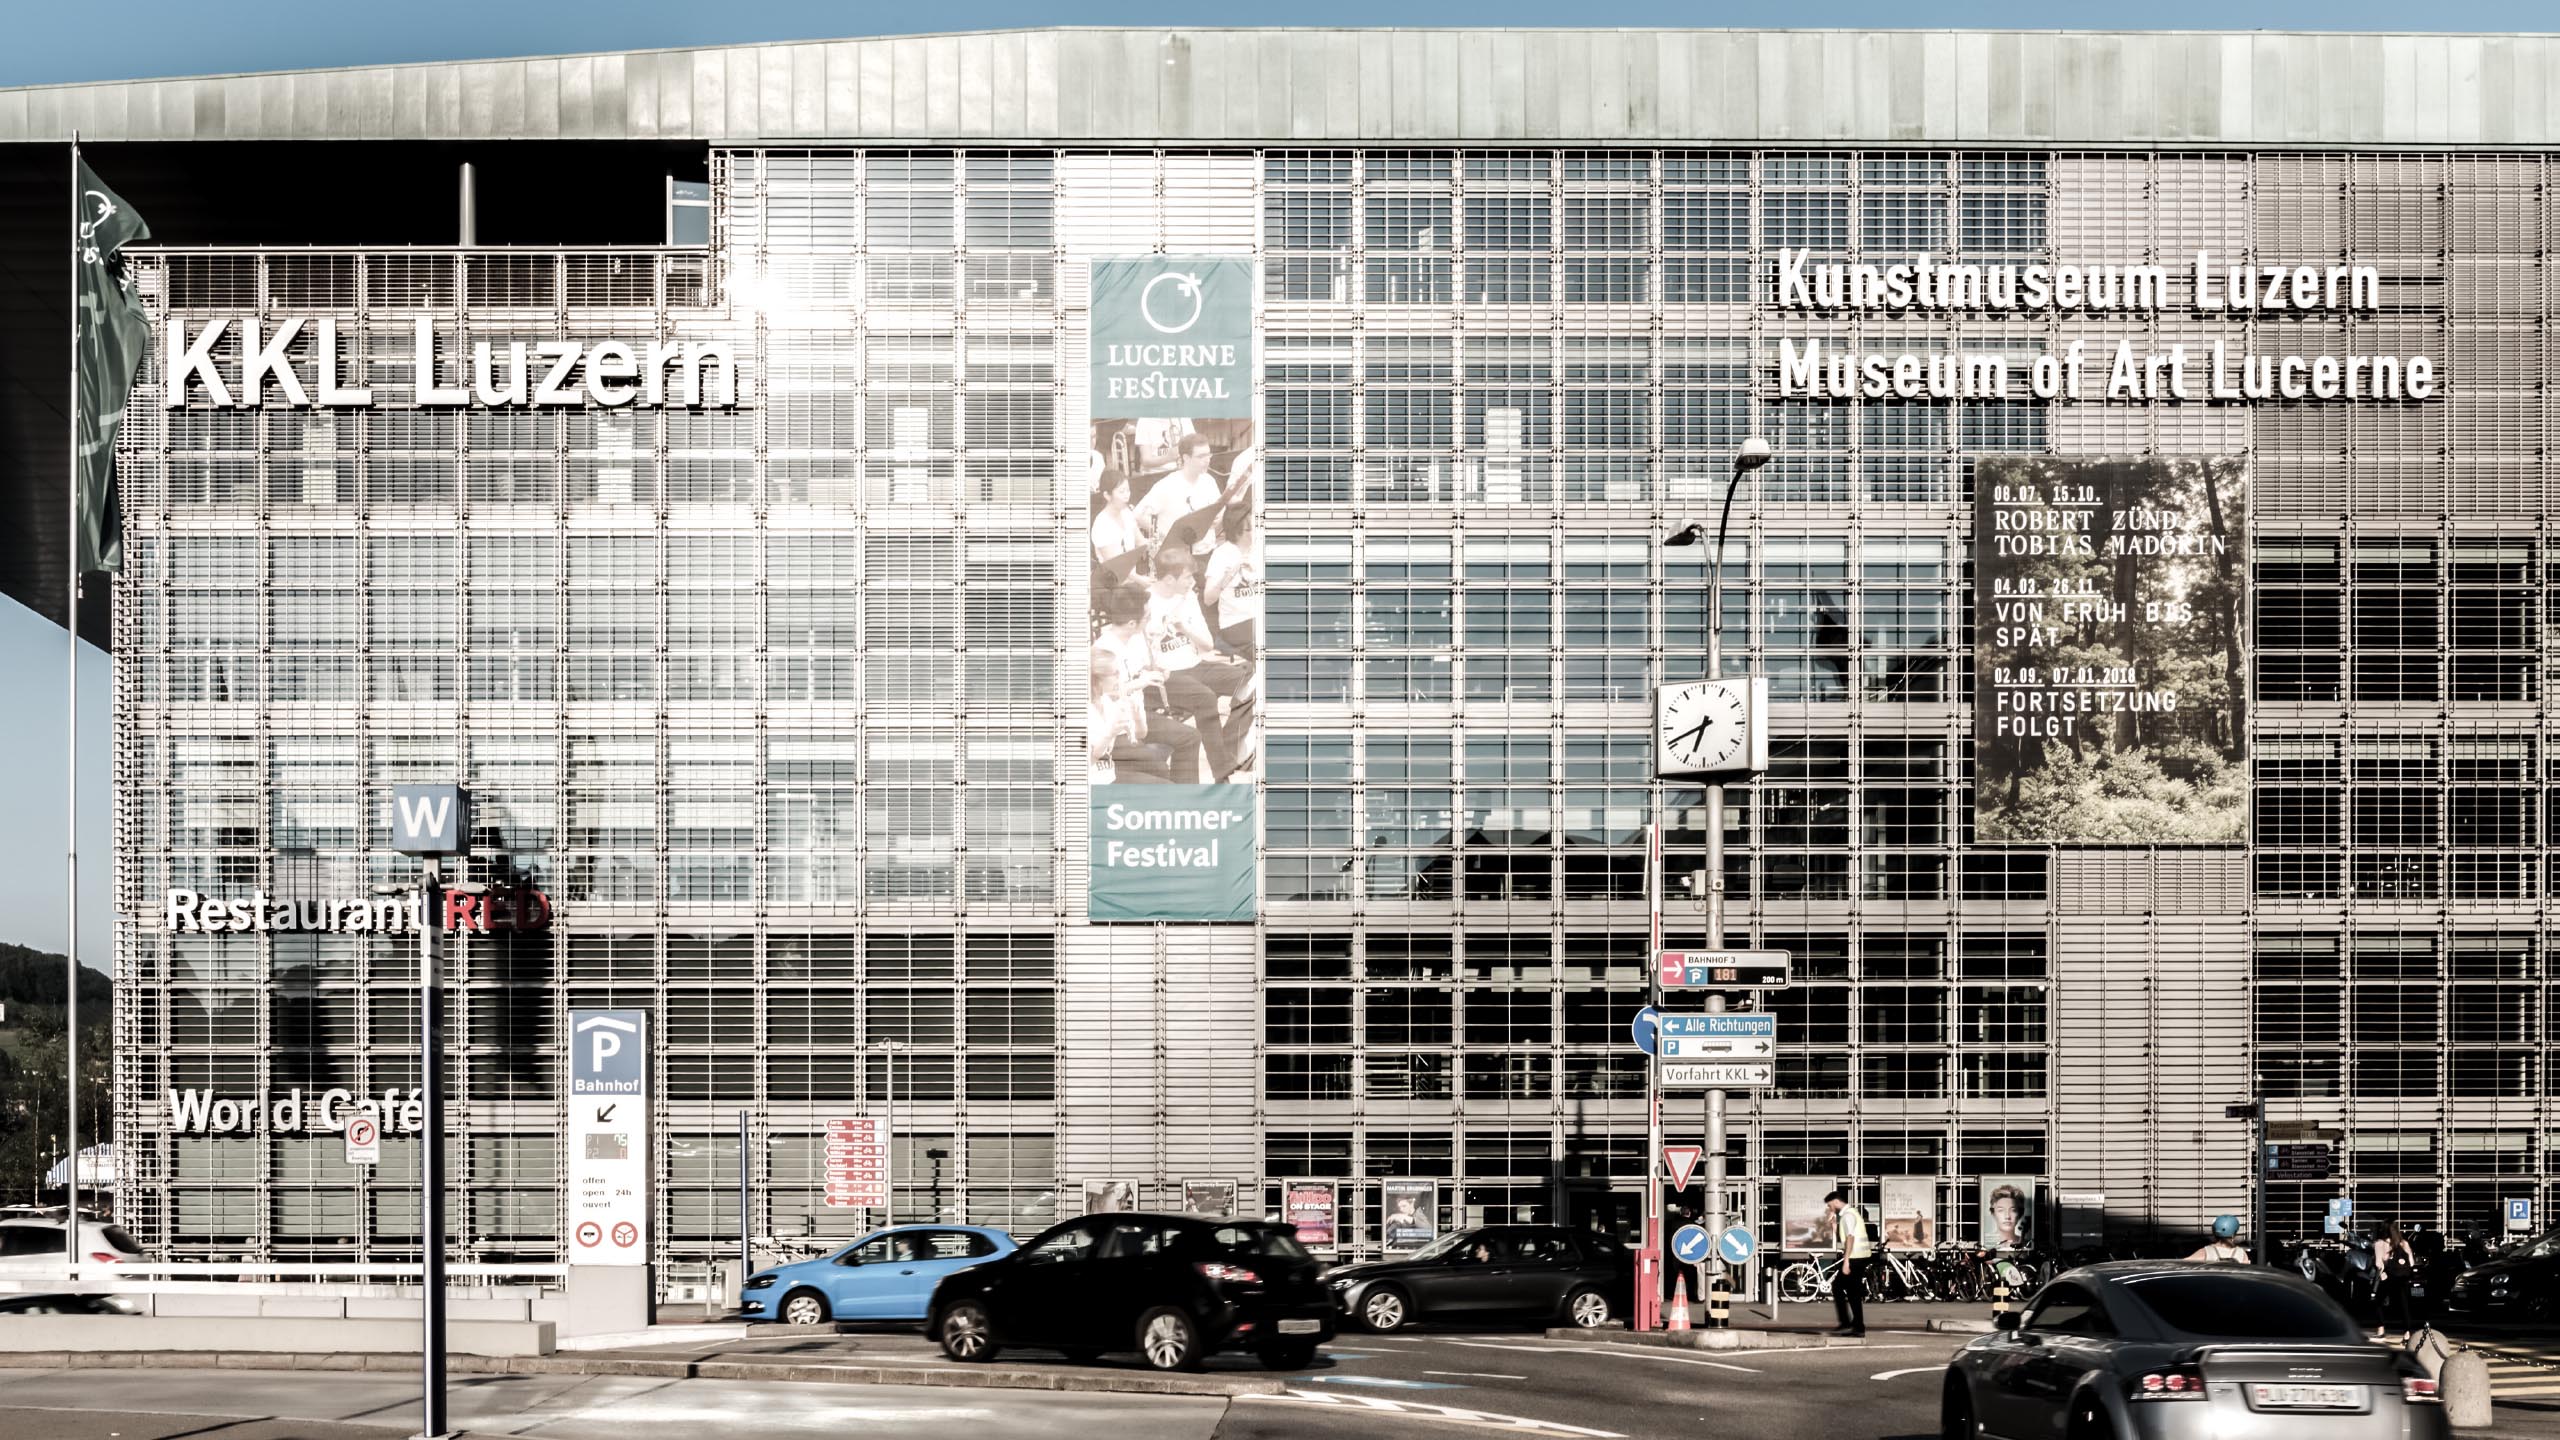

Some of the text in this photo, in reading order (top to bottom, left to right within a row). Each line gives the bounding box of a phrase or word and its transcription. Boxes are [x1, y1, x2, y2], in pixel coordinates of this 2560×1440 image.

[1779, 247, 2378, 308] Kunstmuseum Luzern
[167, 317, 738, 406] KKL Luzern
[1107, 344, 1236, 366] LUCERNE
[1779, 338, 2433, 399] Museum of Art Lucerne
[1107, 371, 1230, 399] FESTIVAL
[1994, 485, 2101, 501] 08.07. 15.10.
[1995, 506, 2178, 531] ROBERT ZÜND
[1994, 530, 2226, 555] TOBIAS MADÖRIN
[1994, 578, 2101, 594] 04.03. 26.11.
[1995, 597, 2193, 622] VON FRÜH BIS
[1996, 623, 2059, 647] SPÄT
[1994, 667, 2136, 684] 02.09. 07.01.2018
[1997, 691, 2176, 712] FORTSETZUNG
[1997, 716, 2076, 737] FOLGT
[398, 796, 451, 838] W
[1106, 803, 1243, 830] Sommer-
[1107, 838, 1218, 867] Festival
[166, 888, 550, 931] Restaurant RED
[1688, 956, 1736, 964] BAHNHOF 3
[1691, 969, 1737, 983] P 181
[1762, 976, 1775, 984] 200
[1685, 1018, 1771, 1035] Alle Richtungen
[592, 1031, 621, 1072] P
[1667, 1042, 1676, 1053] P
[1666, 1068, 1750, 1080] Vorfahrt KKL
[575, 1079, 639, 1092] Bahnhof
[168, 1088, 301, 1132] World
[582, 1176, 606, 1184] offen
[582, 1188, 632, 1198] open 24h
[582, 1200, 611, 1208] ouvert
[2513, 1202, 2523, 1217] P
